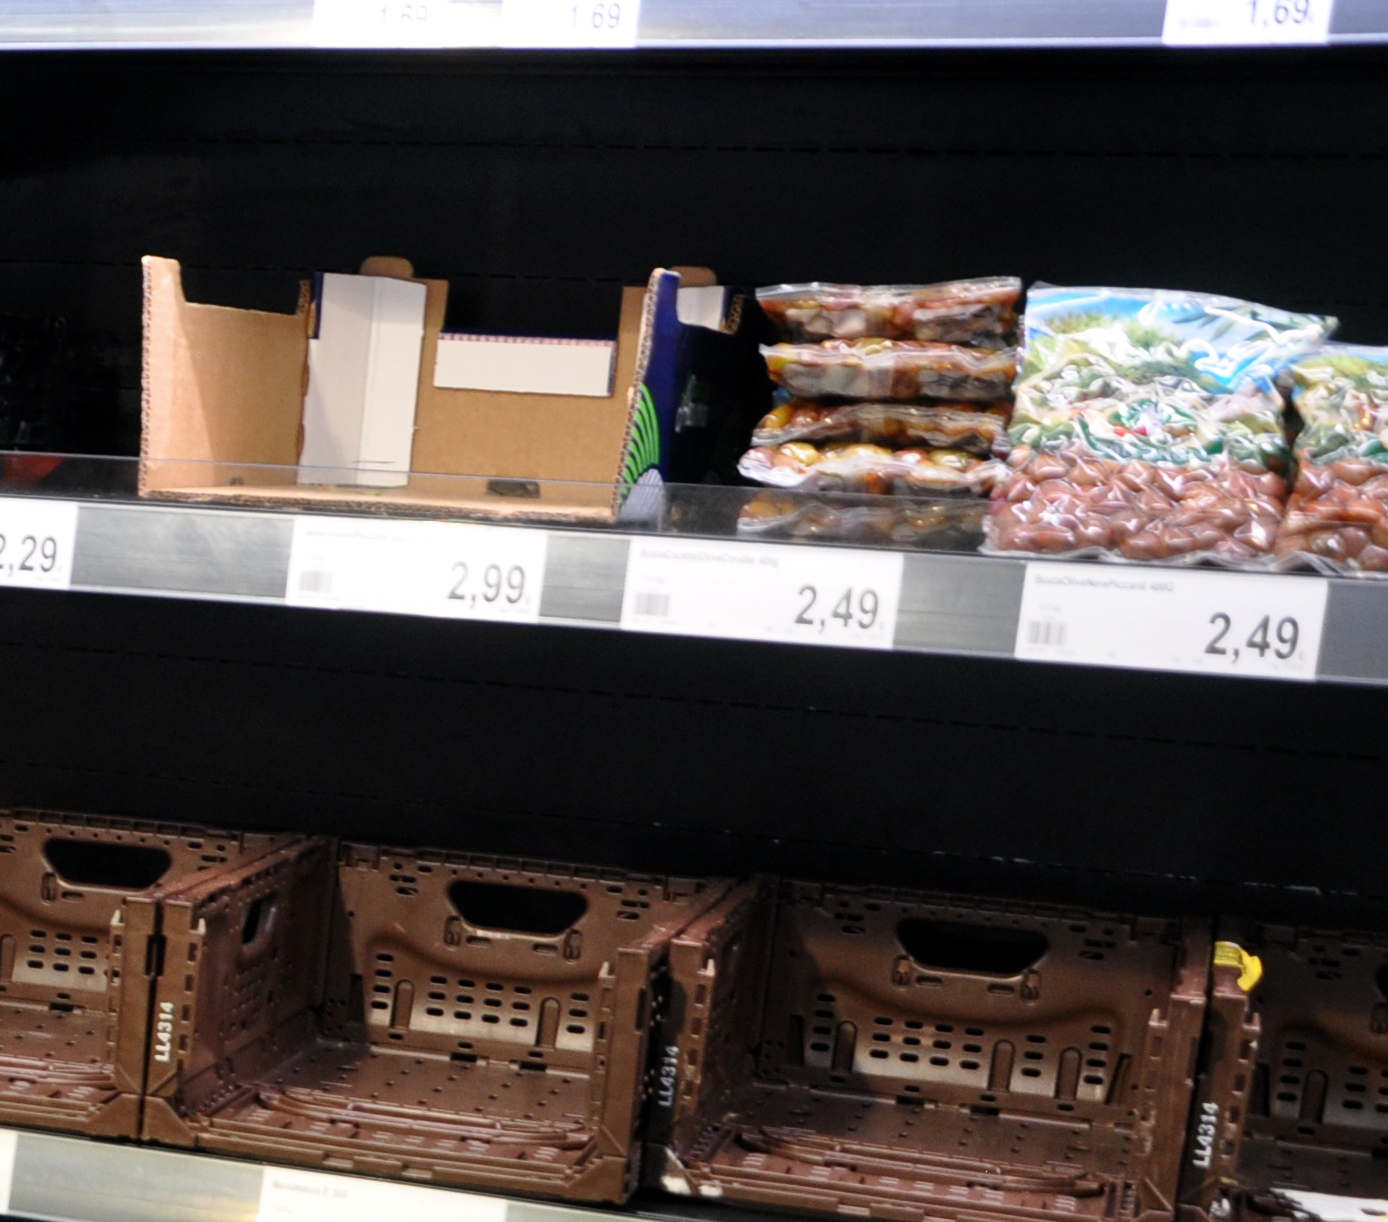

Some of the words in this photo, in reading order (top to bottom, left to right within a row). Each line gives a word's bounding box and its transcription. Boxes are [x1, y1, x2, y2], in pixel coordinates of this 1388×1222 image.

[446, 560, 527, 609] 2,99
[793, 583, 880, 634] 2,49
[1203, 611, 1301, 664] 2,49
[154, 1001, 174, 1063] LL4314
[656, 1045, 680, 1107] LL4314
[1191, 1101, 1220, 1169] LL4314
